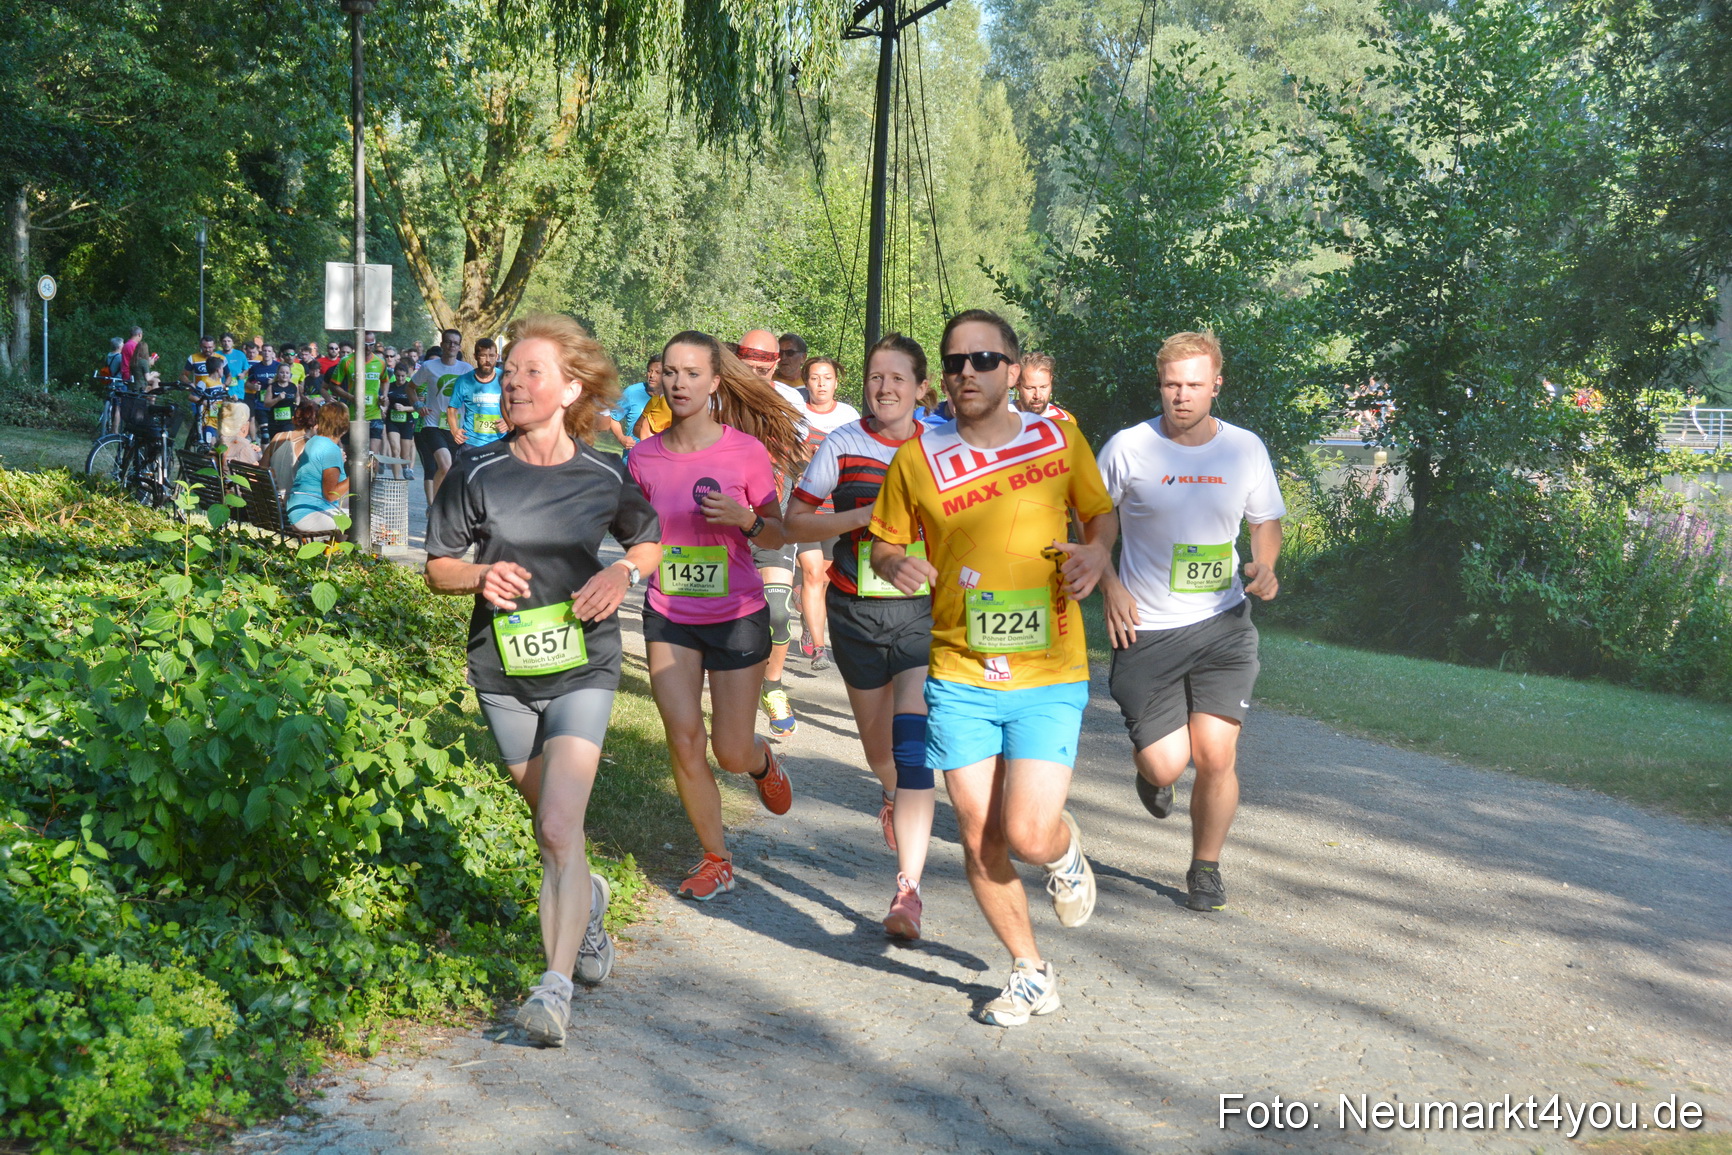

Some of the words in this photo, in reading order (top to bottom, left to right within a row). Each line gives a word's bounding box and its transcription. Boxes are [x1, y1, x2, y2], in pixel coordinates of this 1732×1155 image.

[942, 481, 1003, 517] MAX
[1008, 458, 1070, 491] BÖGL
[1178, 476, 1228, 484] KLEBL
[668, 563, 718, 583] 1437
[1187, 561, 1223, 580] 876
[689, 581, 715, 589] Katharina
[976, 611, 1040, 634] 1224
[508, 626, 571, 658] 1657
[982, 634, 1006, 642] Pöhner
[1007, 633, 1035, 641] Dominik
[547, 652, 566, 663] Lydia
